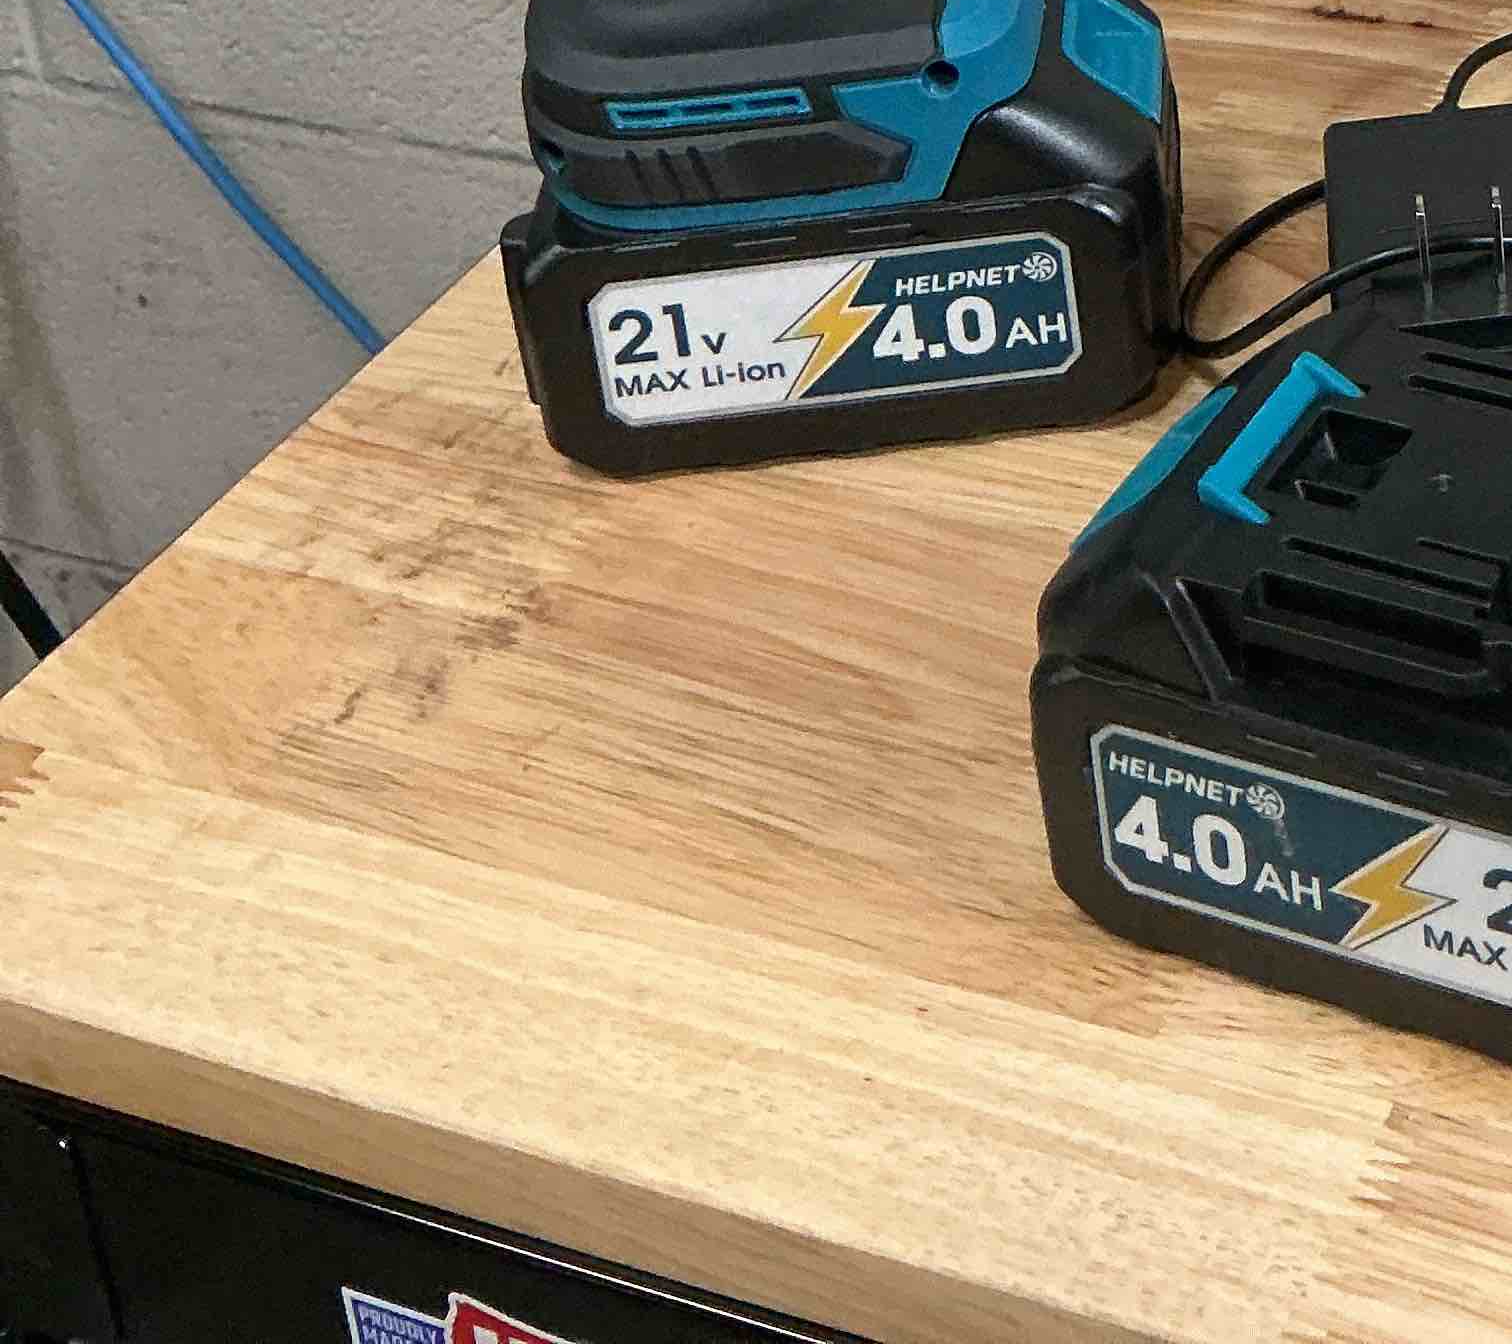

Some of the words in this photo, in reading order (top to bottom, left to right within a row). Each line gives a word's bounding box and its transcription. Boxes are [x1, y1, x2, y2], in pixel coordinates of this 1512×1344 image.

[895, 264, 1021, 298] HELPNET
[871, 295, 998, 363] 4.0
[1005, 312, 1068, 350] AH
[614, 367, 689, 399] MAX
[1108, 750, 1245, 808] HELPNET
[1113, 794, 1249, 887] 4.0
[1255, 862, 1323, 912] AH
[1423, 923, 1506, 972] MAX
